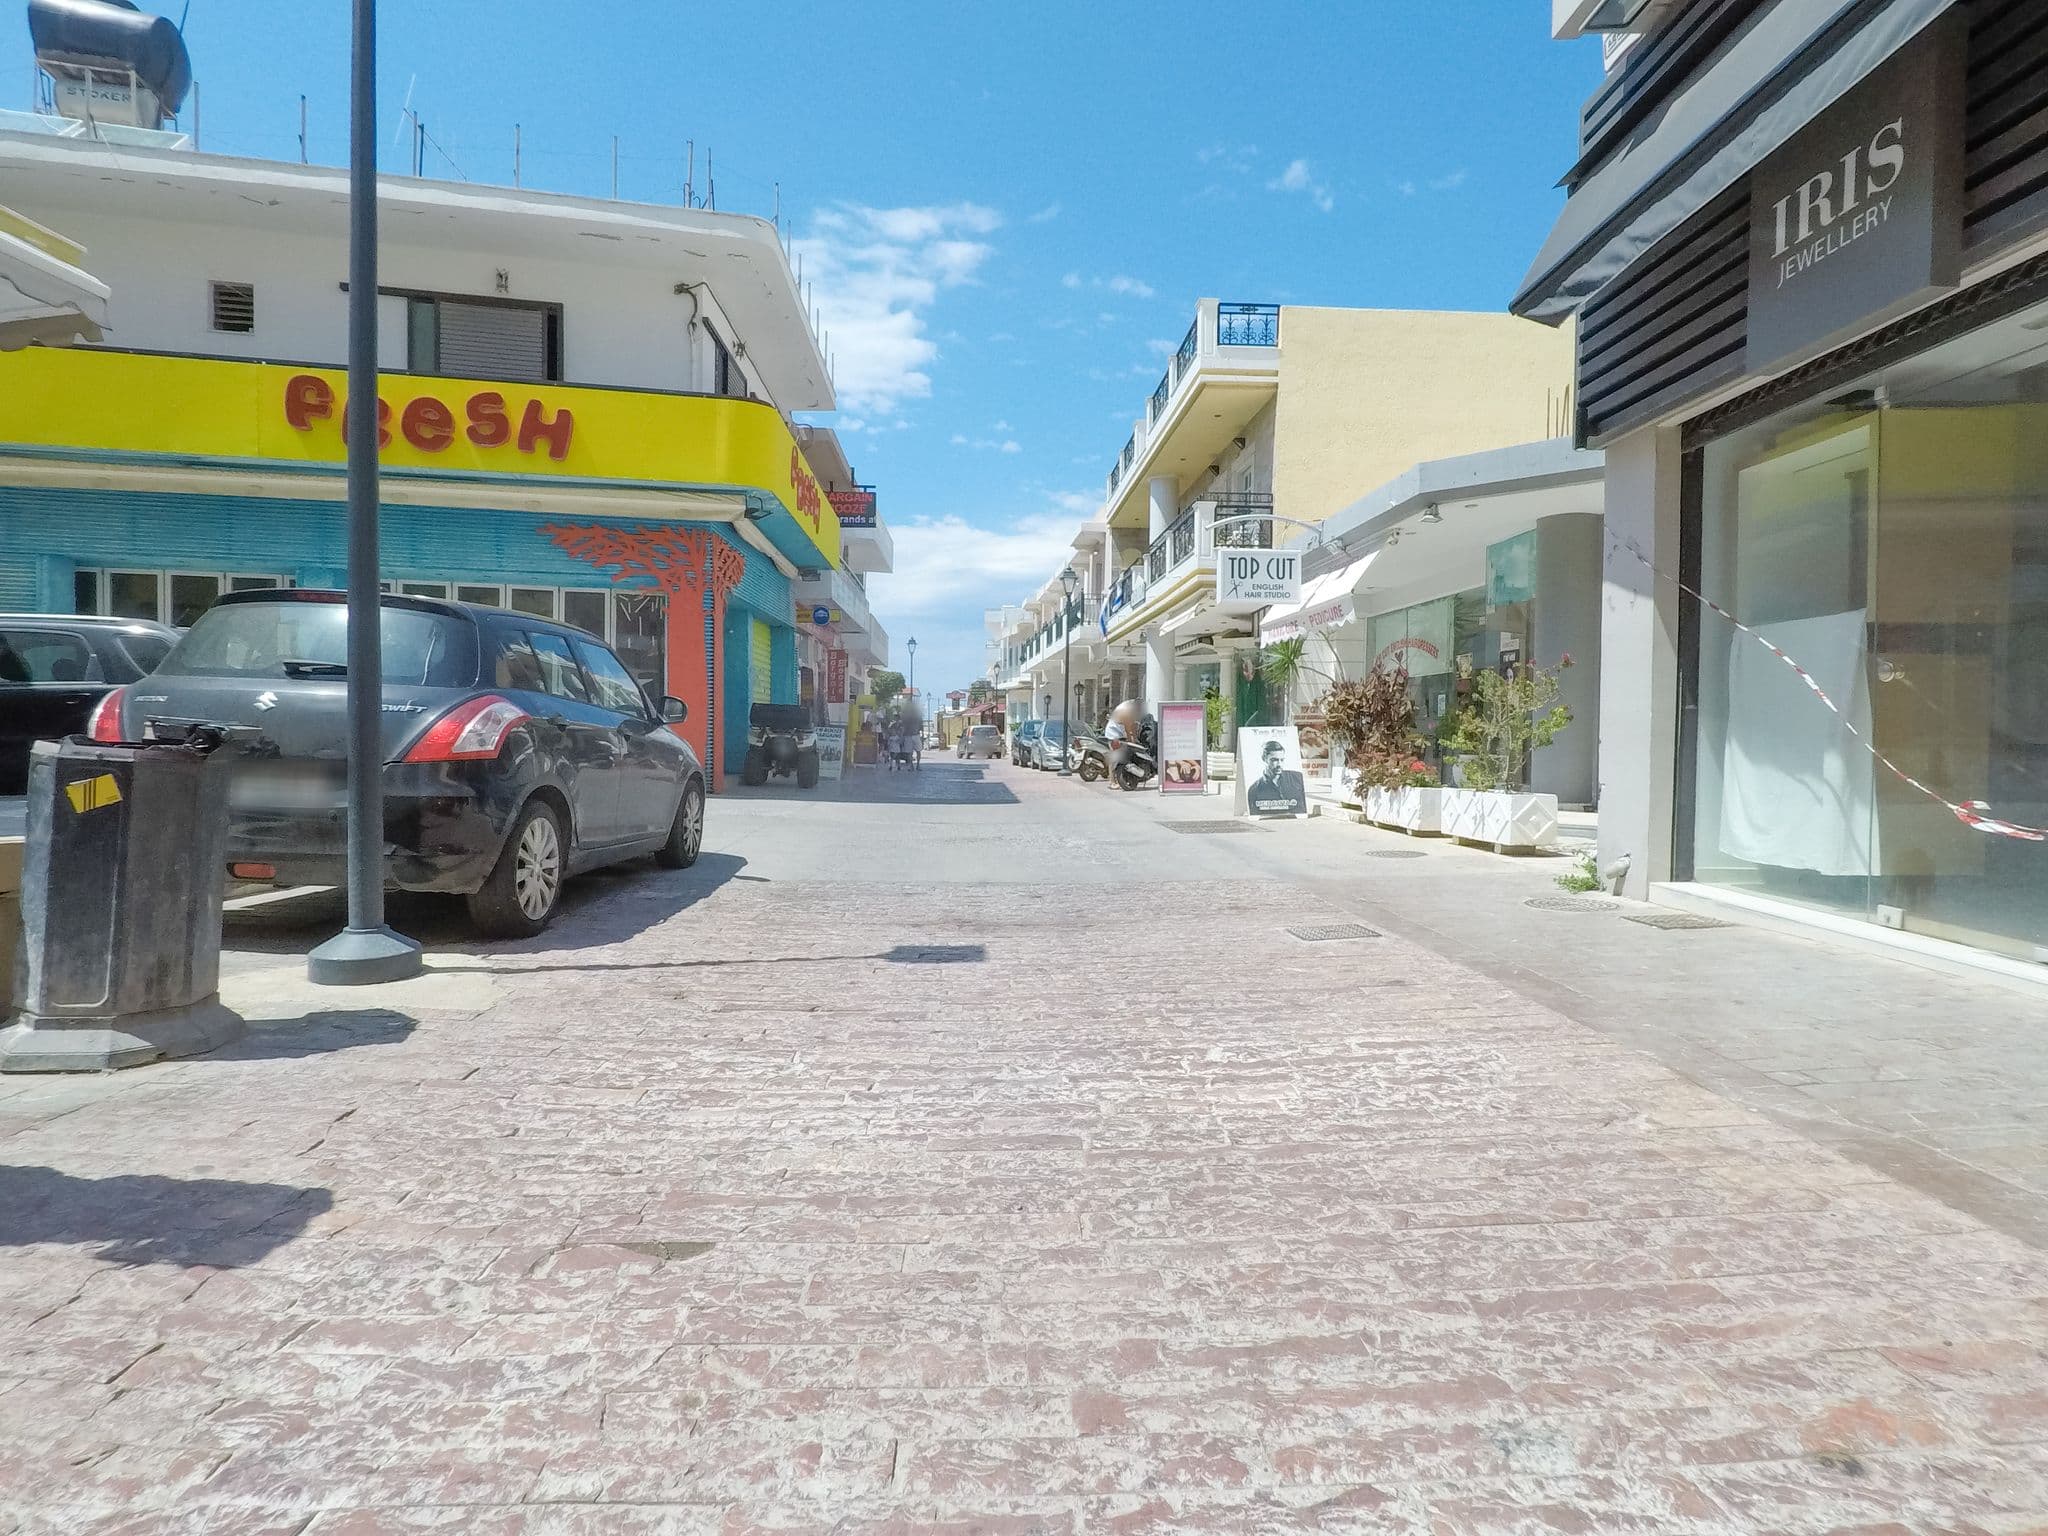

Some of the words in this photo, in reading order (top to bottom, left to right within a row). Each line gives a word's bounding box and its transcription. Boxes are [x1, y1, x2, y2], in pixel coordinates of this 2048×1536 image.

[1771, 116, 1905, 259] IRIS
[1777, 195, 1893, 290] JEWELLERY
[826, 492, 873, 502] ARGAIN
[832, 503, 868, 514] OOZE
[1228, 557, 1260, 580] TOP
[1266, 557, 1296, 580] CUT
[1244, 591, 1262, 599] HAIR
[1263, 591, 1291, 599] STUDIO
[1252, 583, 1284, 591] ENGLISH
[1309, 604, 1344, 628] PEDICURE
